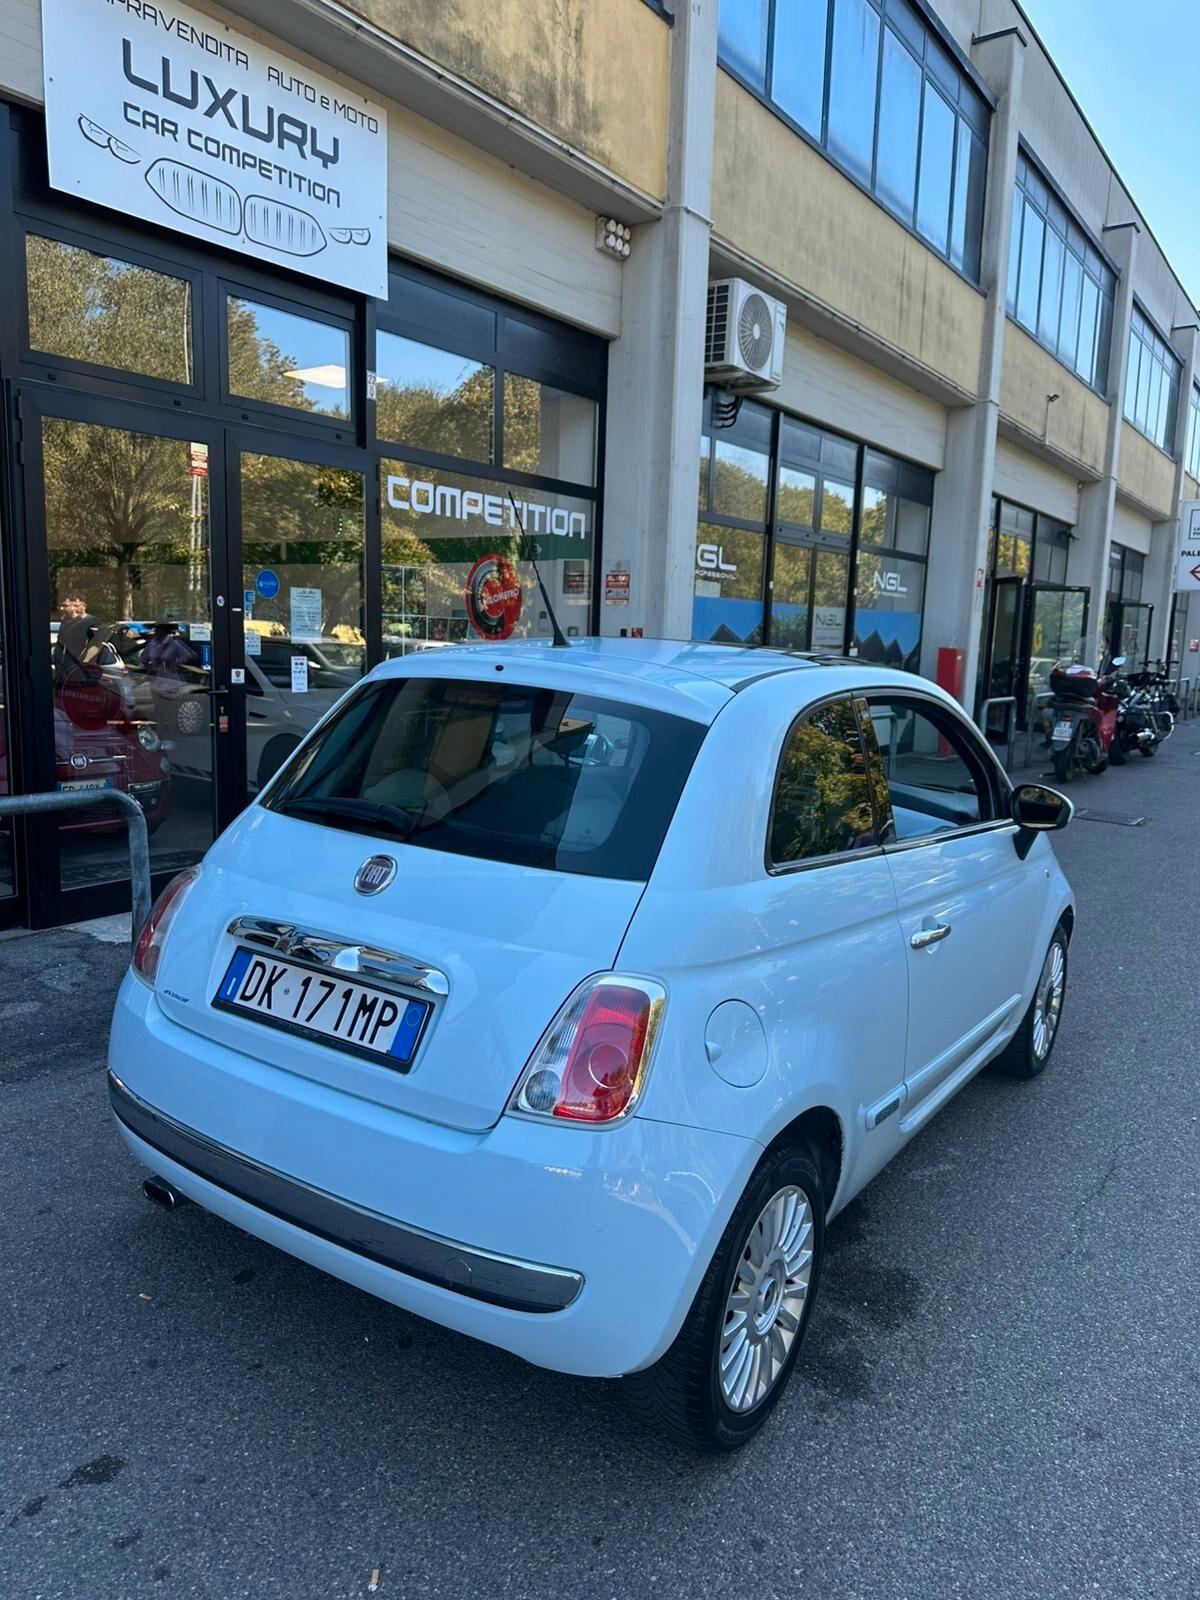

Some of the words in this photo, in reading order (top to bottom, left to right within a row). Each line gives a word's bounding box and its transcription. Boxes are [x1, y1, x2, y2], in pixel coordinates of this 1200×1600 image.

[122, 37, 339, 169] LUXURY
[267, 66, 316, 104] AUTO
[320, 94, 330, 110] e
[334, 99, 378, 134] MOTO
[123, 101, 179, 142] CAR
[187, 127, 340, 208] COMPETITION
[387, 475, 586, 539] COMPETITION
[873, 570, 908, 592] NGL
[815, 613, 842, 626] NGL
[362, 864, 388, 884] FIAT
[239, 960, 288, 1010] DK
[292, 976, 398, 1045] 171MP
